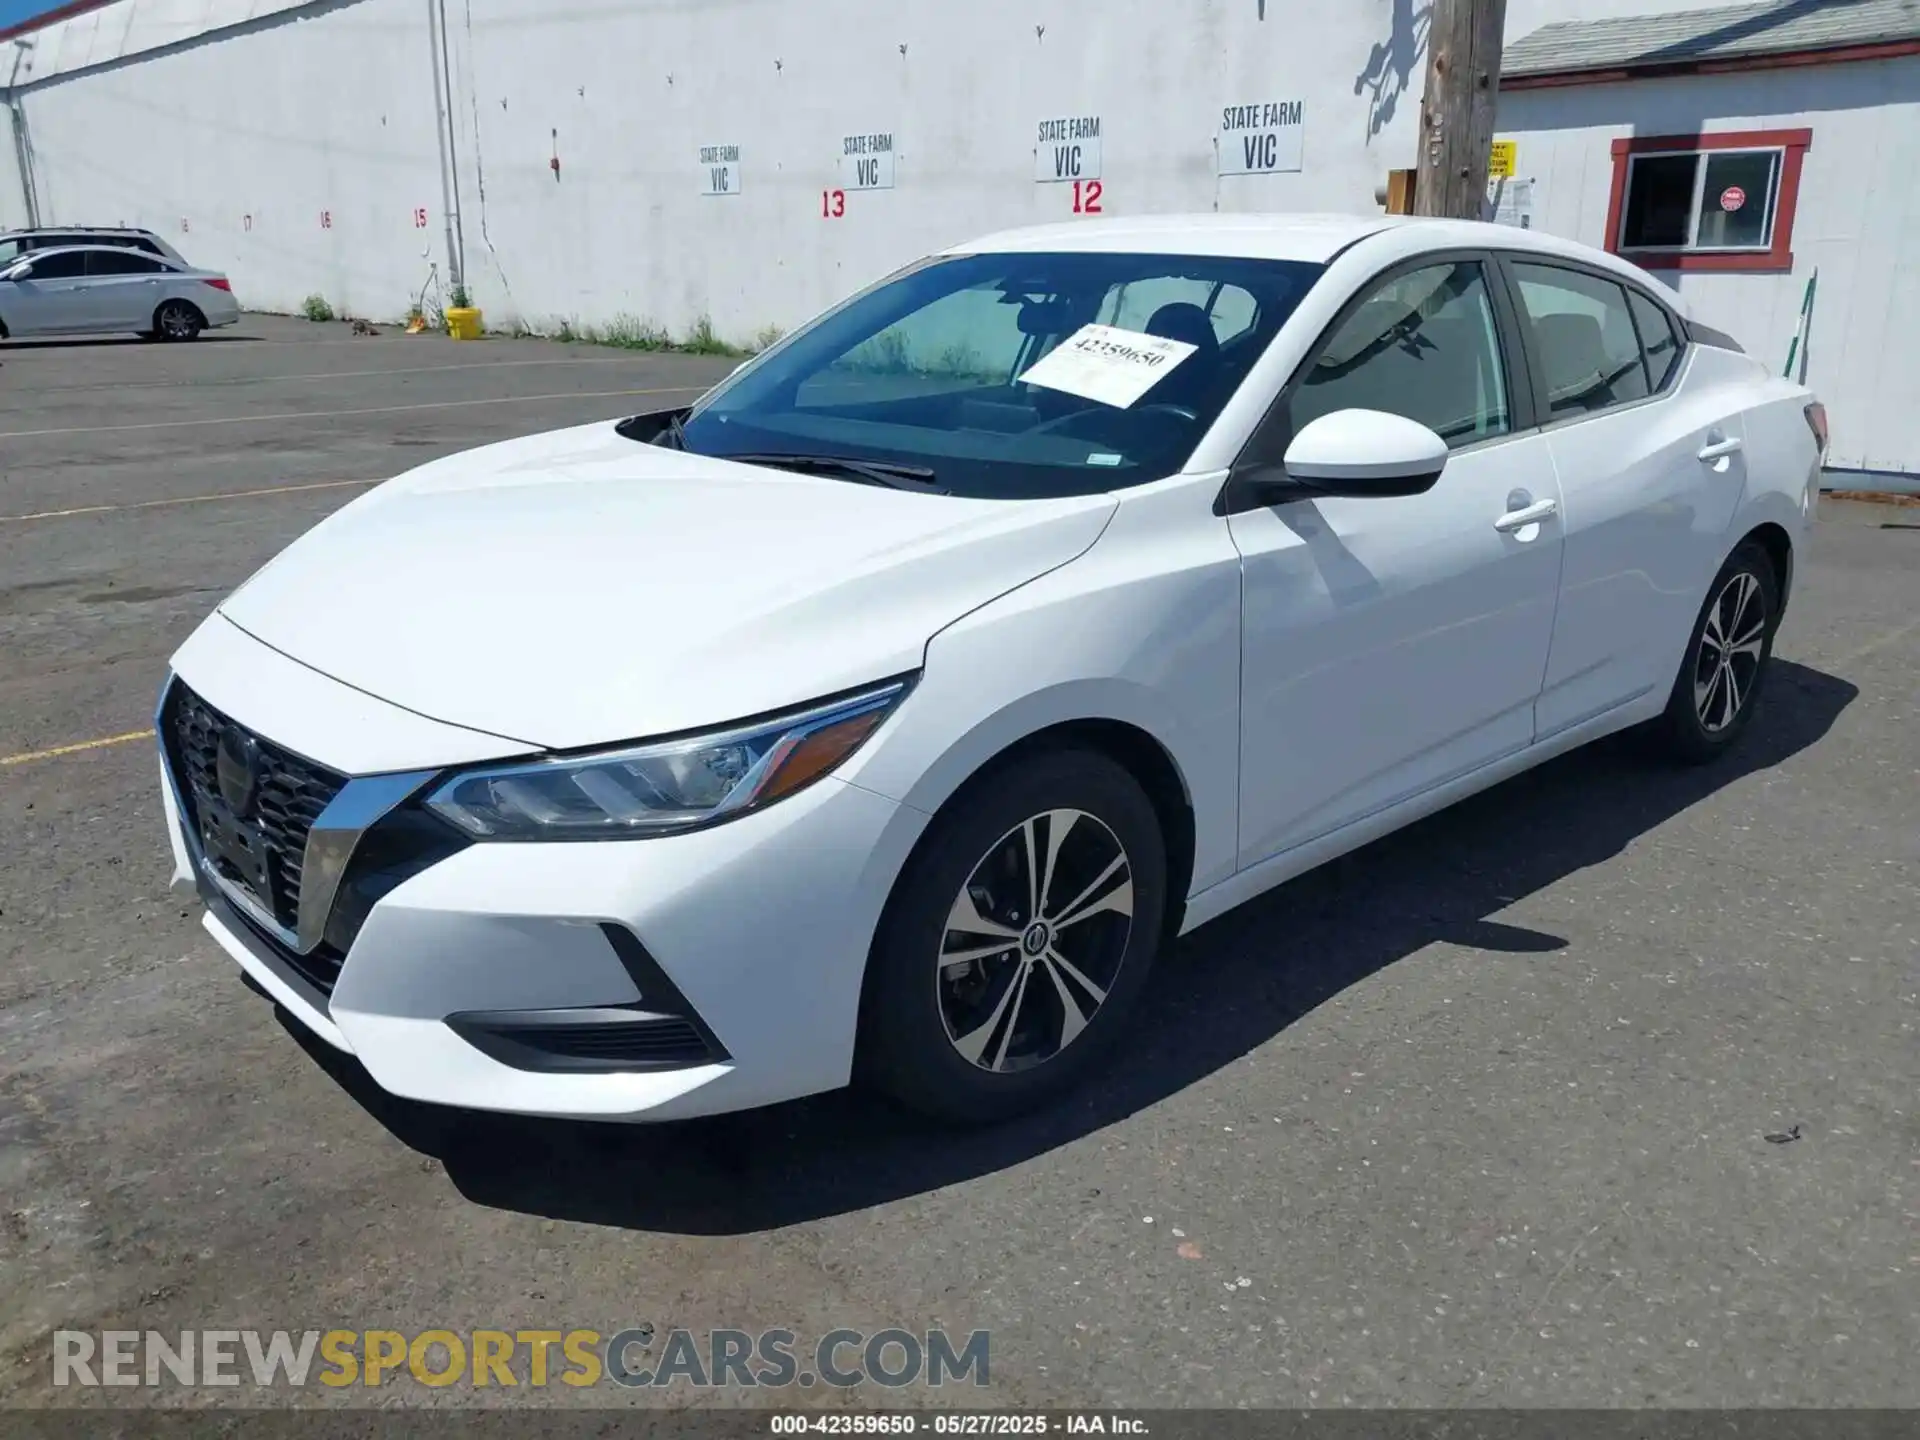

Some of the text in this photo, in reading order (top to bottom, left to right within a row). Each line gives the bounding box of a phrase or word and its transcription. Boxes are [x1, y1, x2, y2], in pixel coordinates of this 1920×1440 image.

[1038, 116, 1100, 142] STATE FARM
[1223, 101, 1302, 131] STATE FARM
[700, 145, 740, 164] STATE FARM
[843, 133, 893, 155] STATE FARM
[1244, 133, 1277, 169] VIC
[857, 158, 879, 186] VIC
[1055, 145, 1081, 177] VIC
[711, 167, 729, 192] VIC
[823, 190, 845, 218] 13
[1073, 181, 1103, 213] 12
[243, 213, 252, 232] 17
[320, 210, 332, 229] 16
[413, 208, 427, 228] 15
[1074, 338, 1166, 367] 42359650
